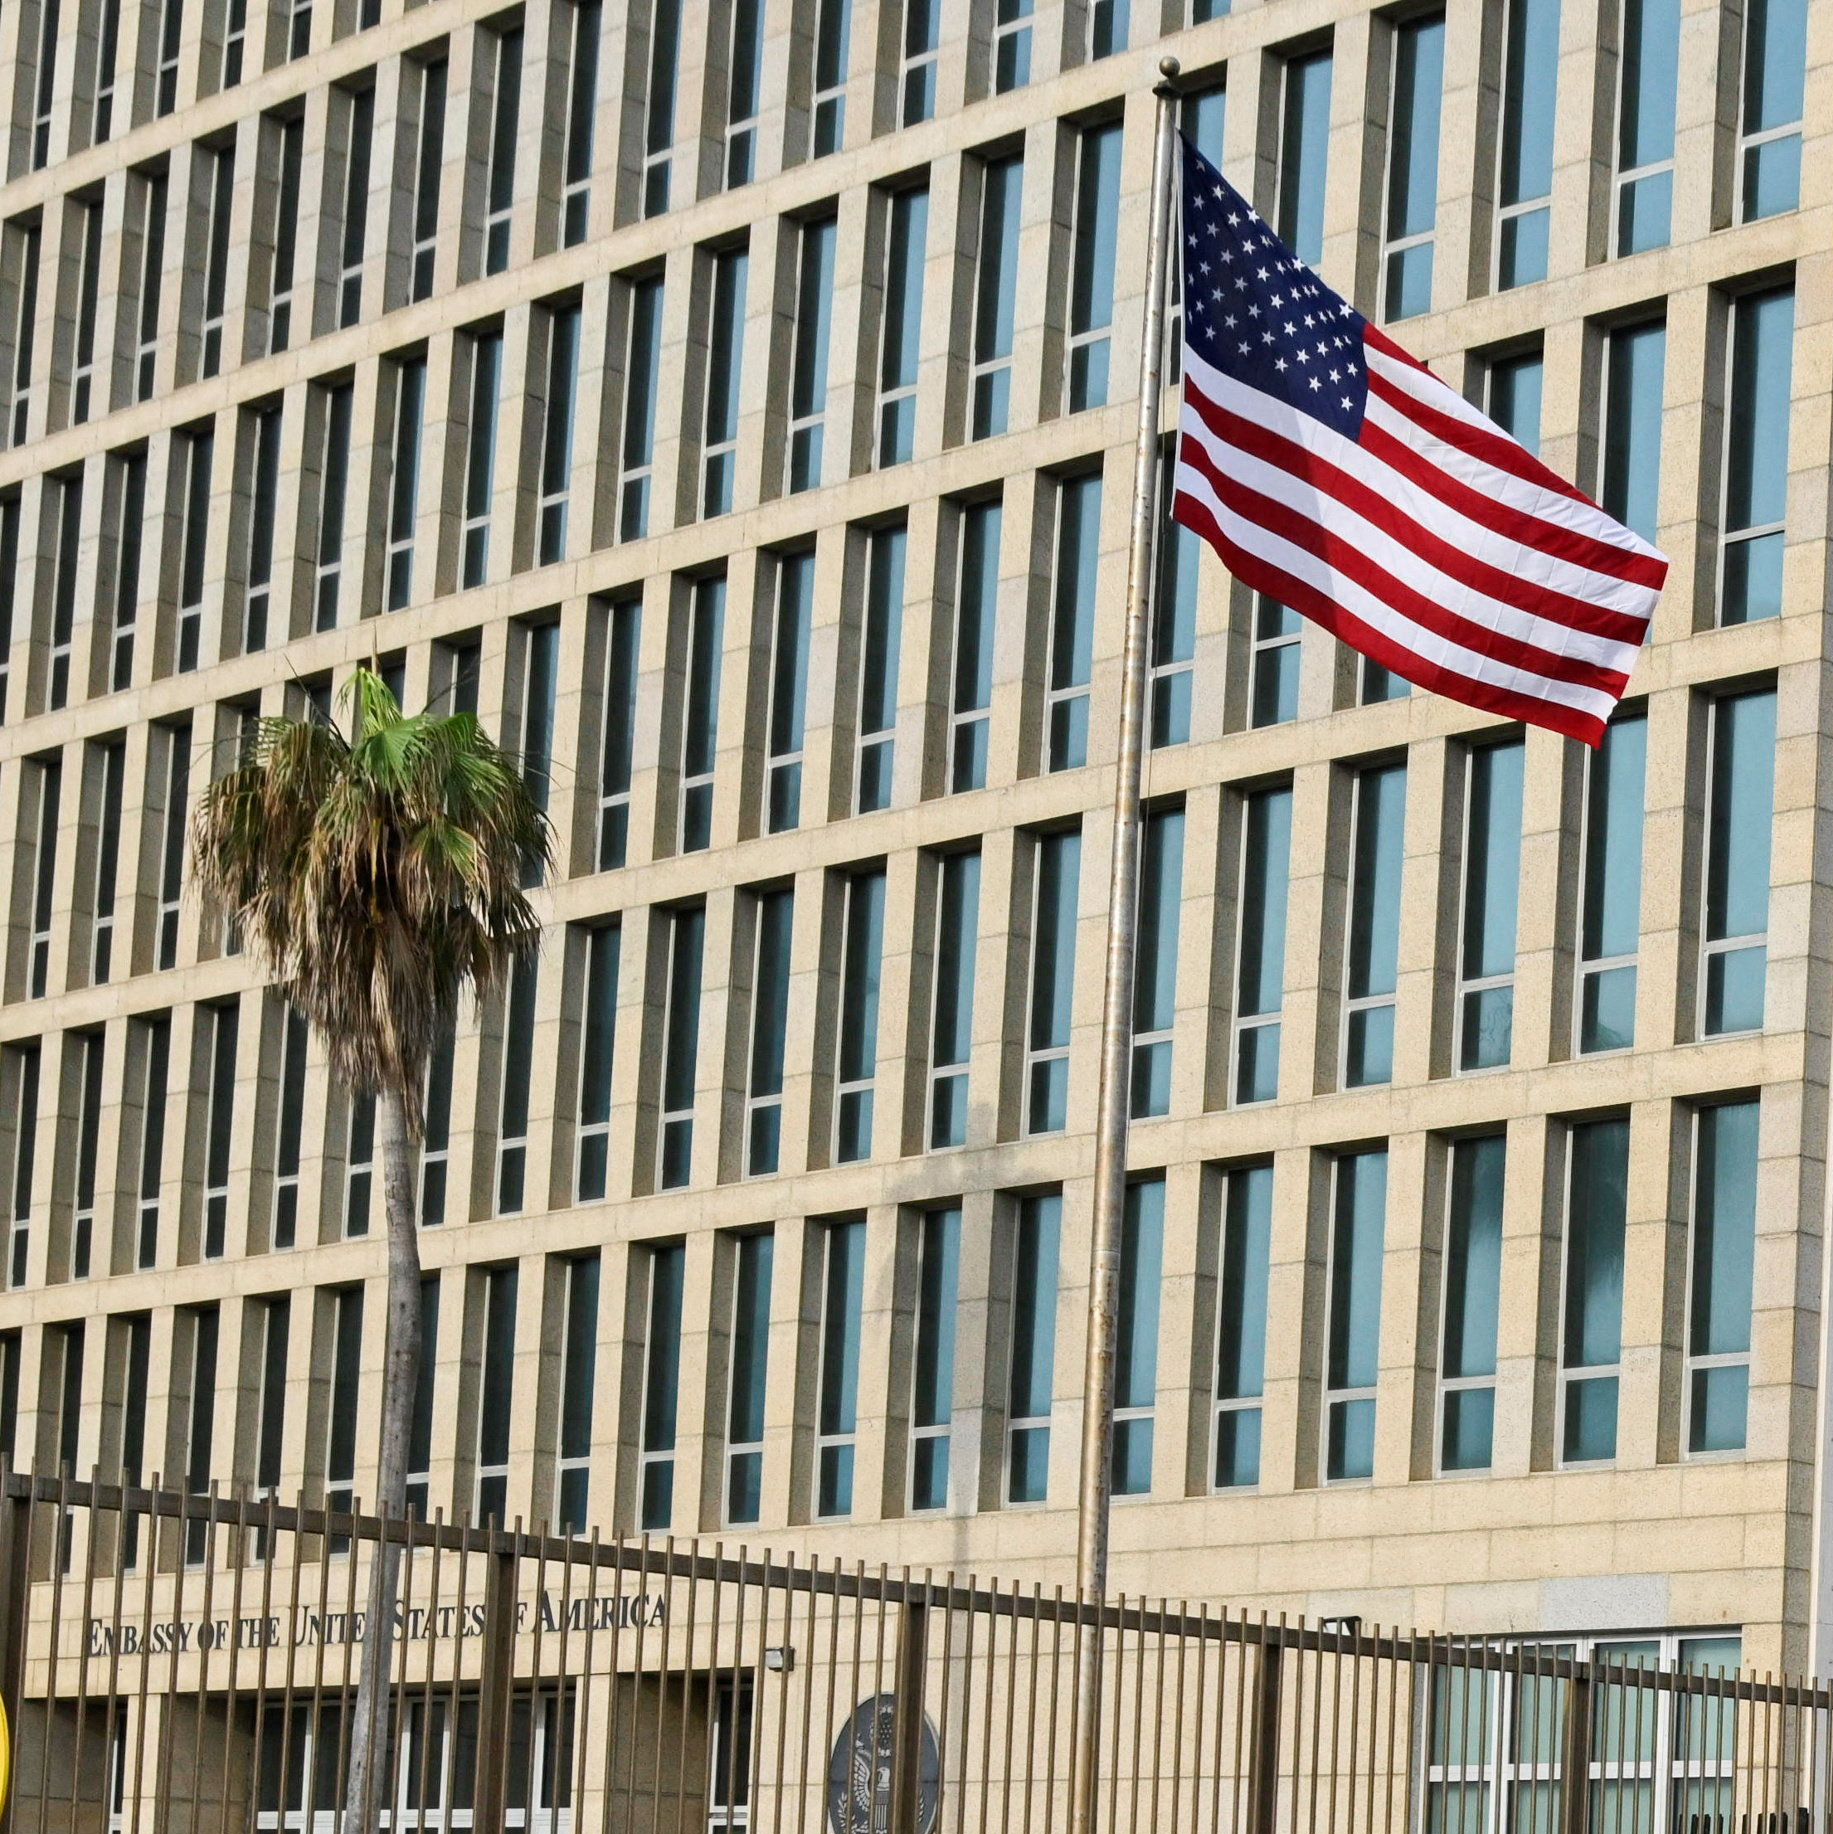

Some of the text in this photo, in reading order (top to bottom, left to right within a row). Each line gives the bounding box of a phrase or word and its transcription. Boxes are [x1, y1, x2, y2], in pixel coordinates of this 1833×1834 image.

[197, 1620, 229, 1650] OF
[288, 1605, 366, 1645] UNITE
[531, 1590, 667, 1633] AMERICA
